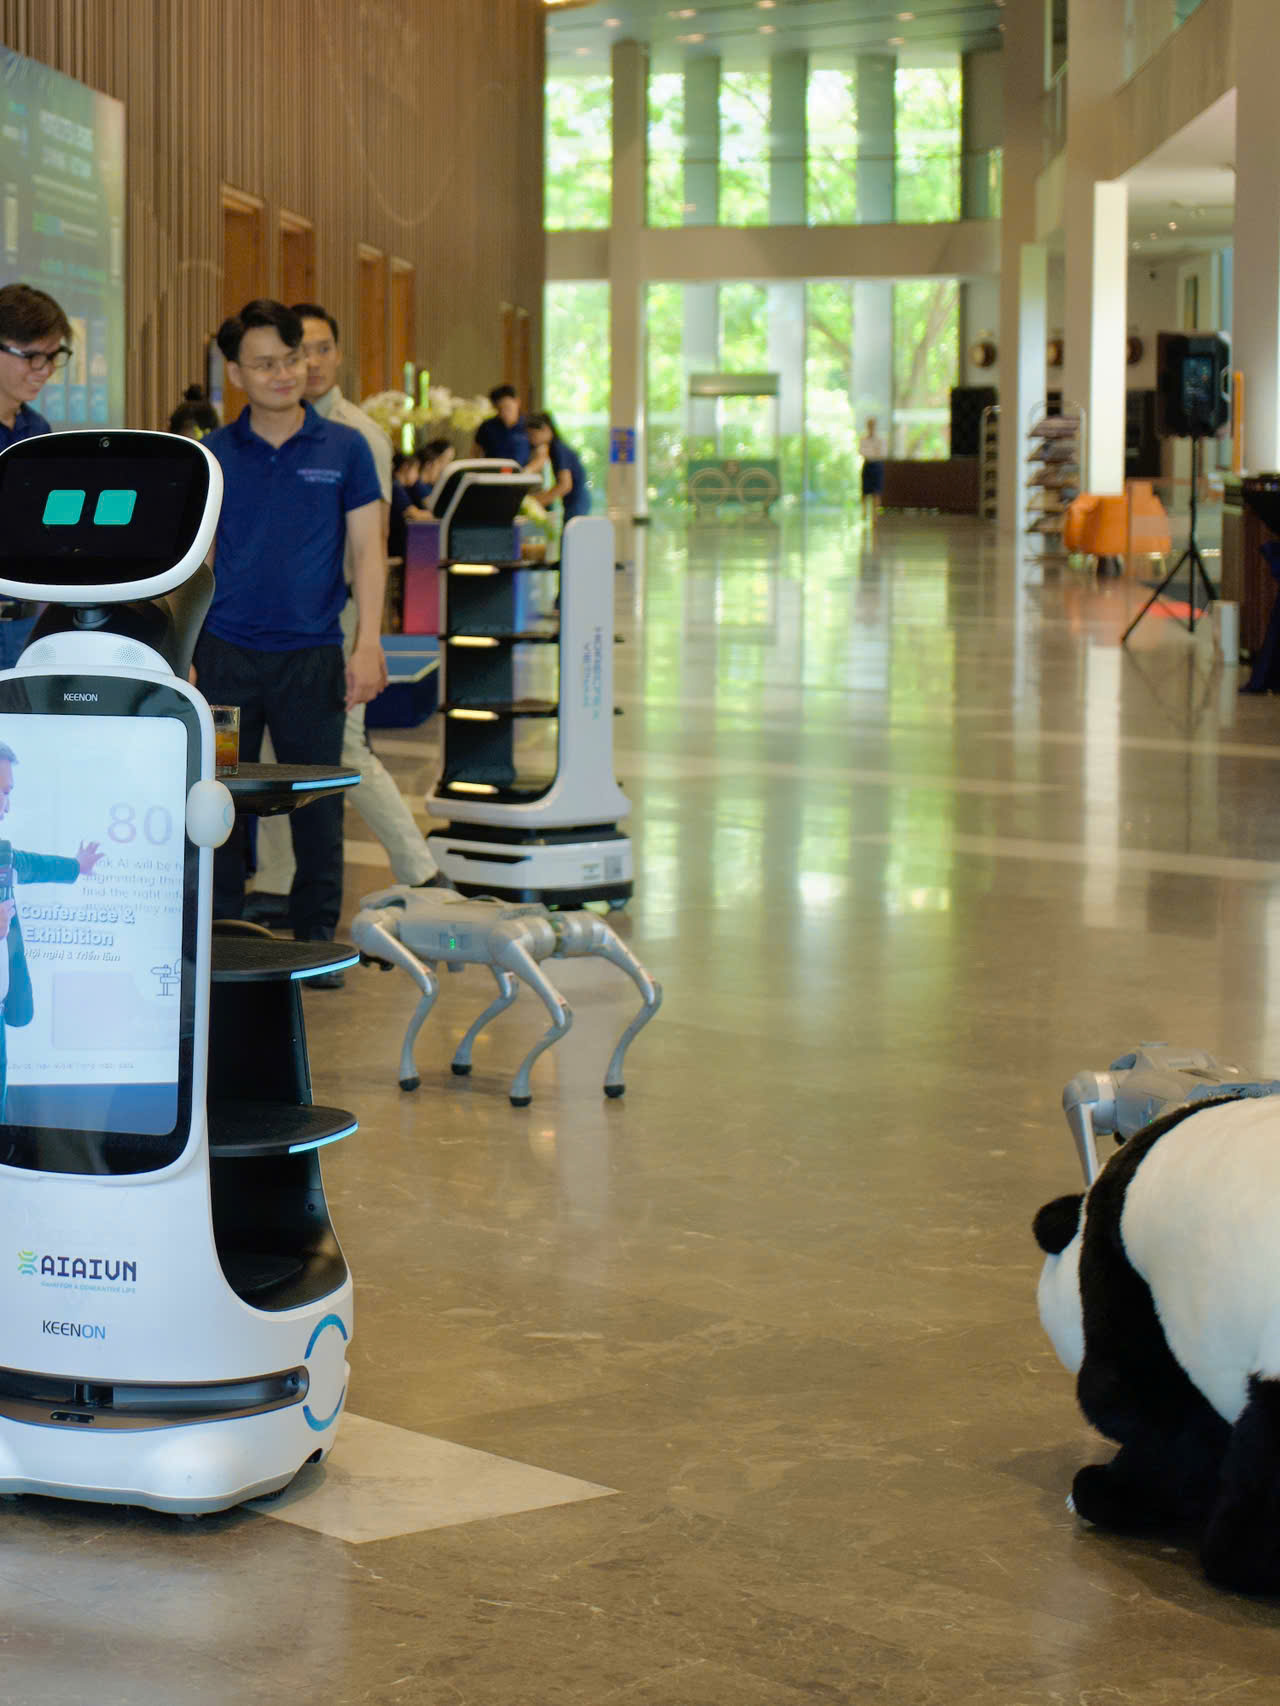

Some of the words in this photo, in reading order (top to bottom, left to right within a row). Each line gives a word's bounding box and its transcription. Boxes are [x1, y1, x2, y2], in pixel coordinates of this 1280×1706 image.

[63, 692, 98, 702] KEENON
[107, 802, 173, 846] 80
[82, 887, 106, 897] find
[110, 887, 127, 897] the
[21, 903, 119, 924] Conference
[122, 909, 136, 925] &
[23, 926, 114, 946] Exhibition
[41, 1255, 137, 1282] AIAIVN
[42, 1320, 106, 1340] KEENON
